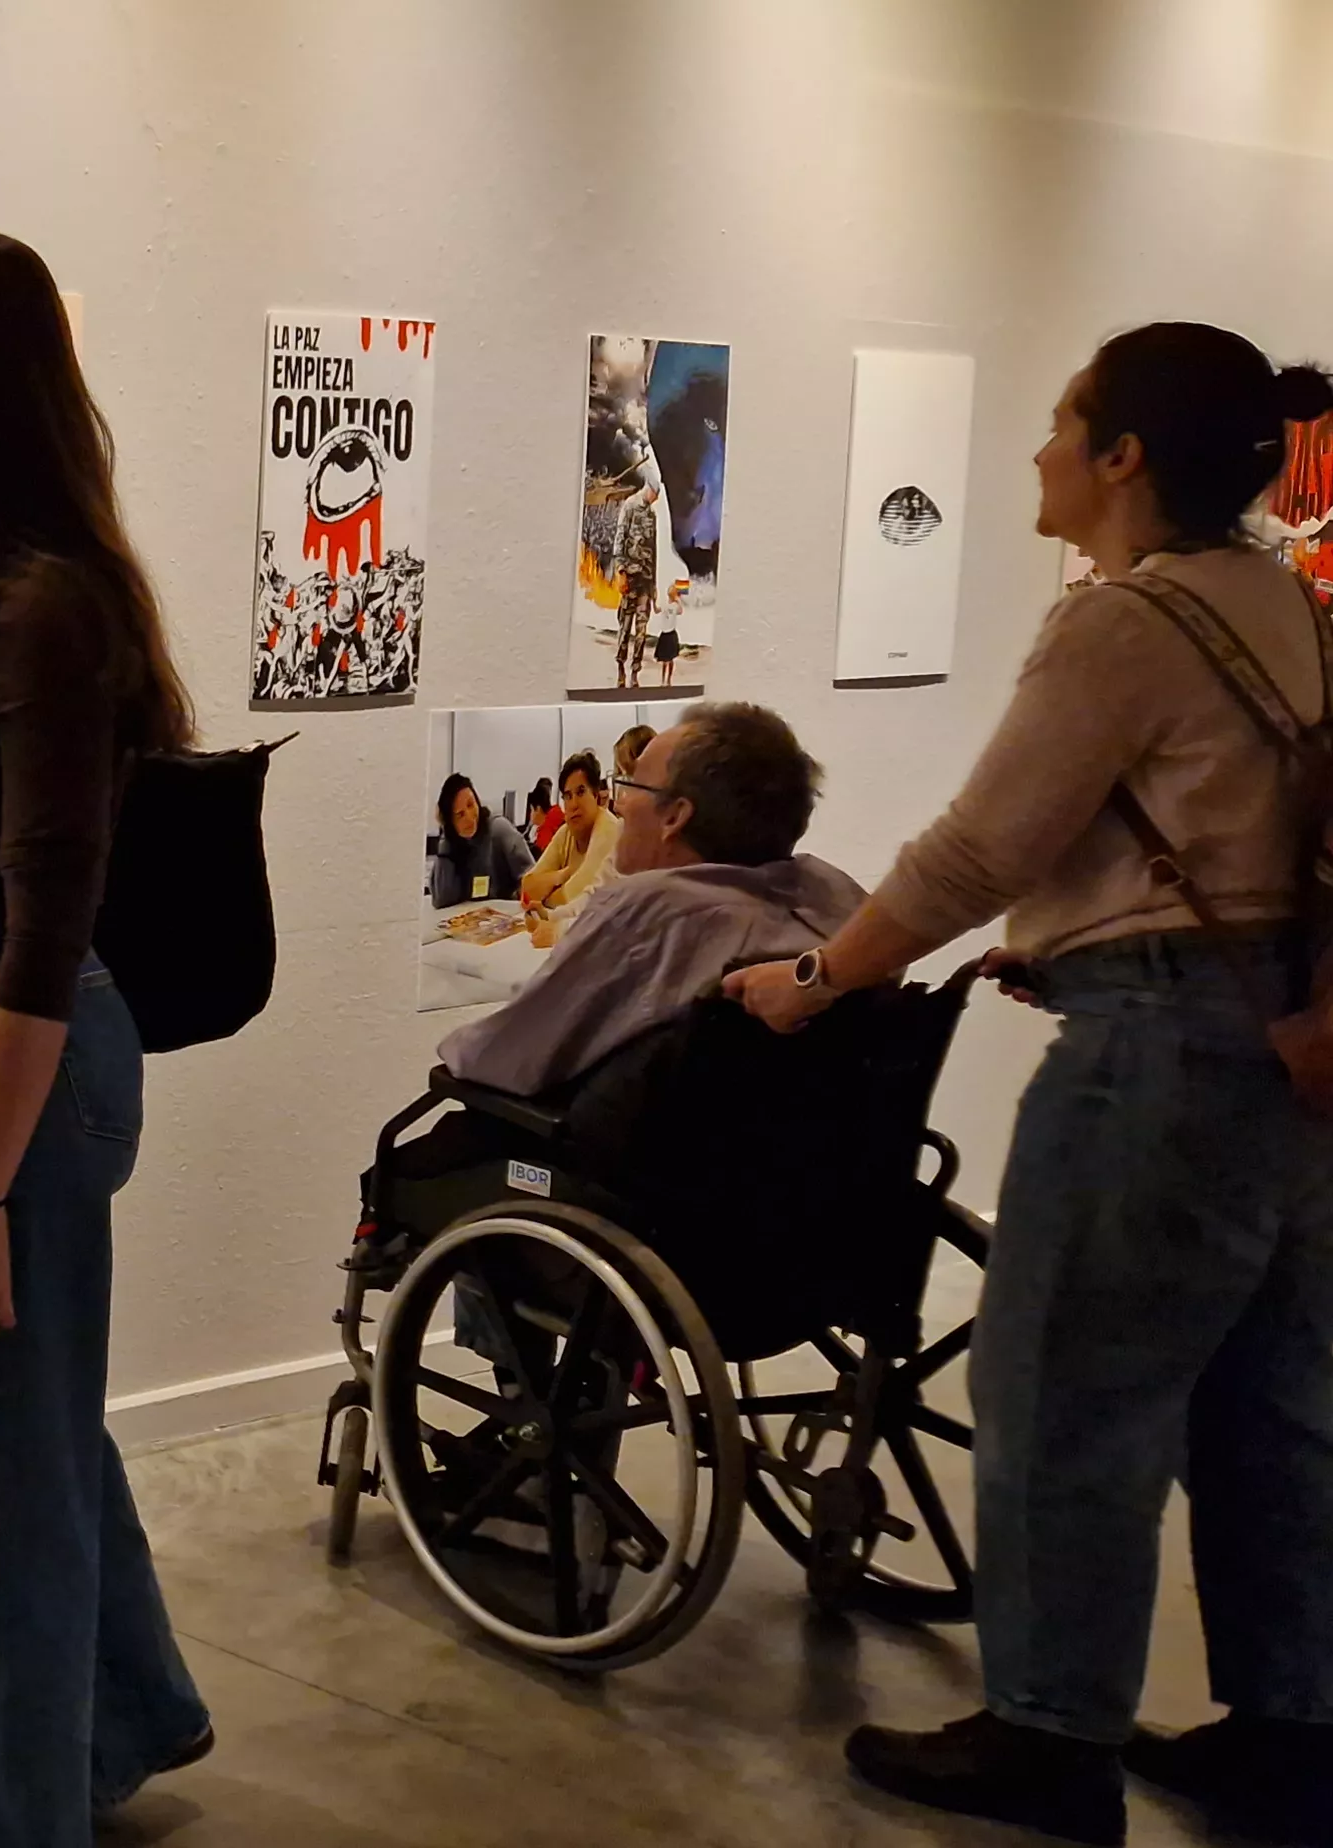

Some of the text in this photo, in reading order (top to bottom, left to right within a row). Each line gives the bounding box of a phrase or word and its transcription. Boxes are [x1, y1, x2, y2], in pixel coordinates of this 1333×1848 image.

[274, 325, 320, 351] LA PAZ
[273, 355, 353, 392] EMPIEZA
[272, 395, 413, 461] CONTIGO
[511, 1162, 549, 1187] IBOR
